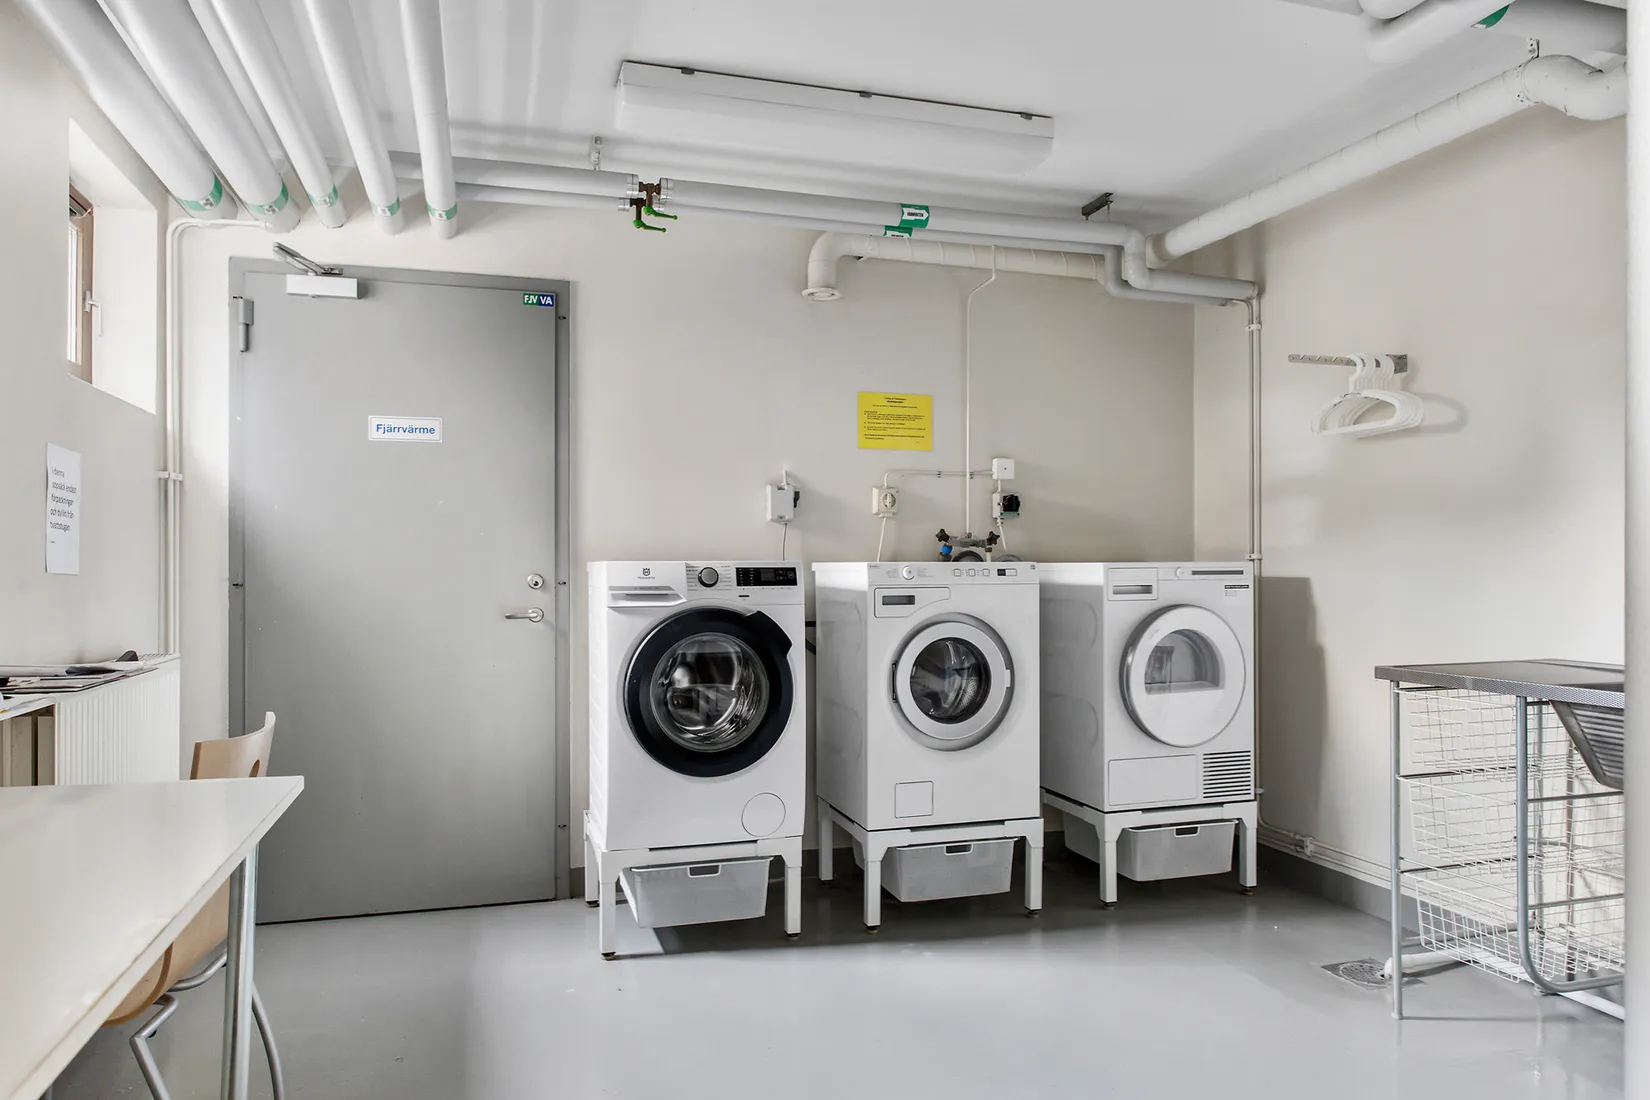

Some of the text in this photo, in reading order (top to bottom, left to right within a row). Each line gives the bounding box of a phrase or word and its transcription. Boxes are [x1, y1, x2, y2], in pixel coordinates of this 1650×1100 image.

[524, 295, 553, 305] FJV VA
[376, 423, 436, 435] Fjärrvärme
